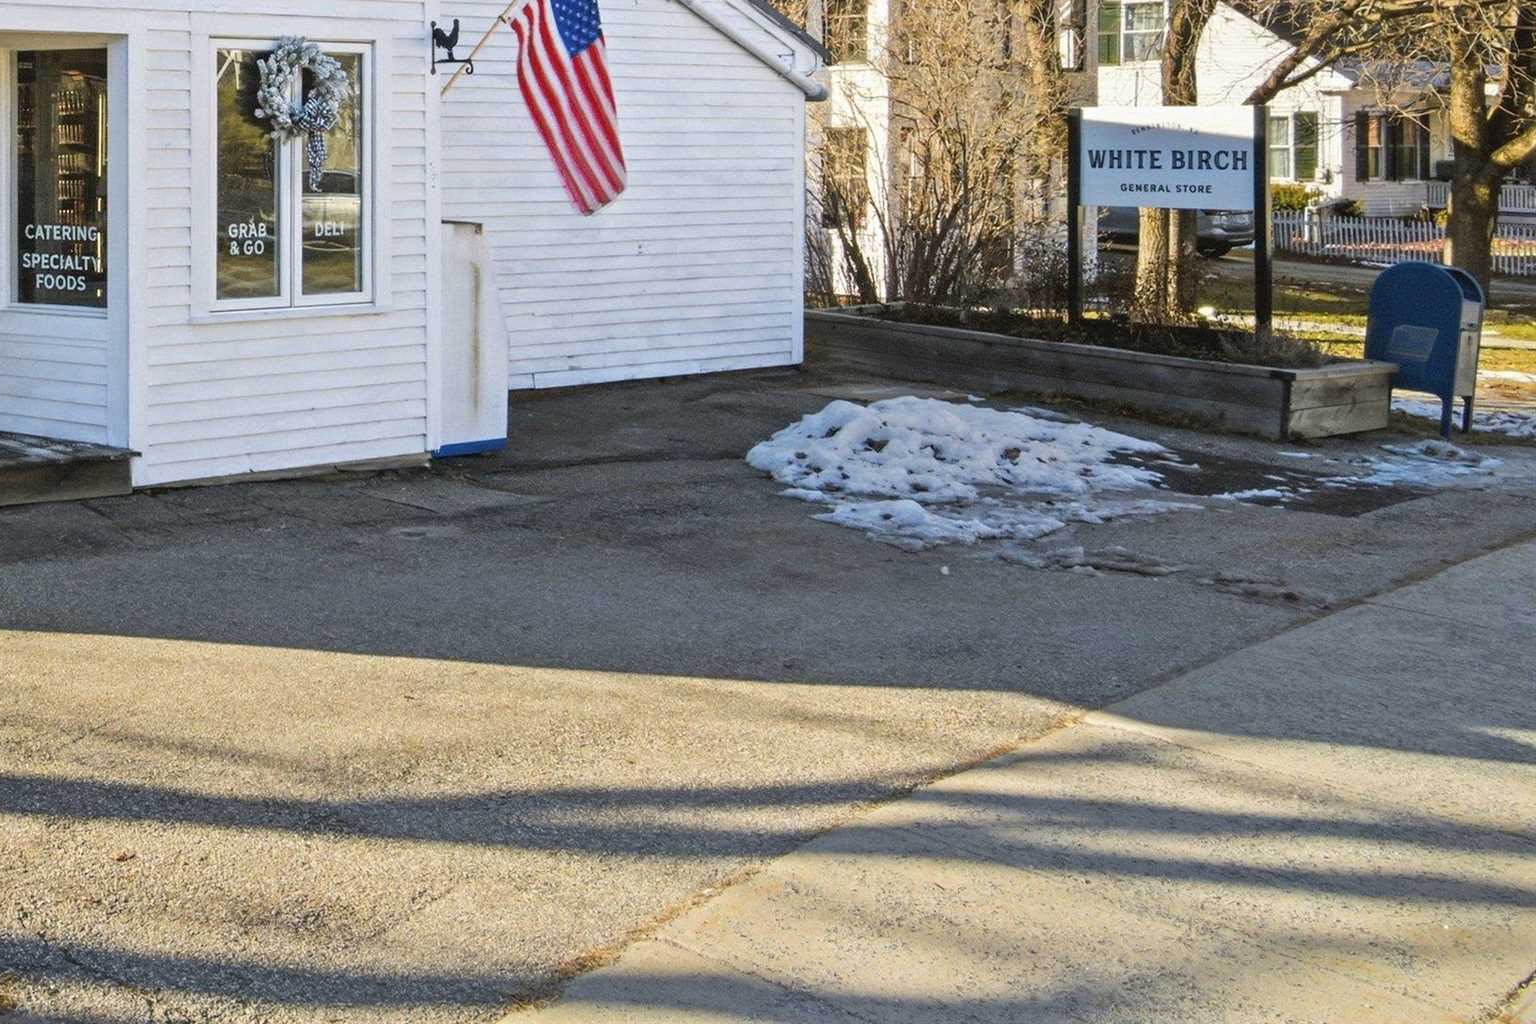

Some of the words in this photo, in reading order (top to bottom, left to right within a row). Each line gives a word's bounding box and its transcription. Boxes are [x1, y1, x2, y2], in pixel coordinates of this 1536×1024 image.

[1087, 149, 1162, 169] WHITE
[1171, 150, 1248, 171] BIRCH
[1120, 183, 1171, 193] GENERAL
[1175, 184, 1213, 194] STORE
[24, 224, 98, 242] CATERING
[228, 222, 267, 239] GRAB
[314, 221, 344, 237] DELI
[229, 241, 240, 255] &
[243, 240, 265, 255] GO
[22, 253, 100, 271] SPECIALTY
[35, 274, 86, 291] FOODS
